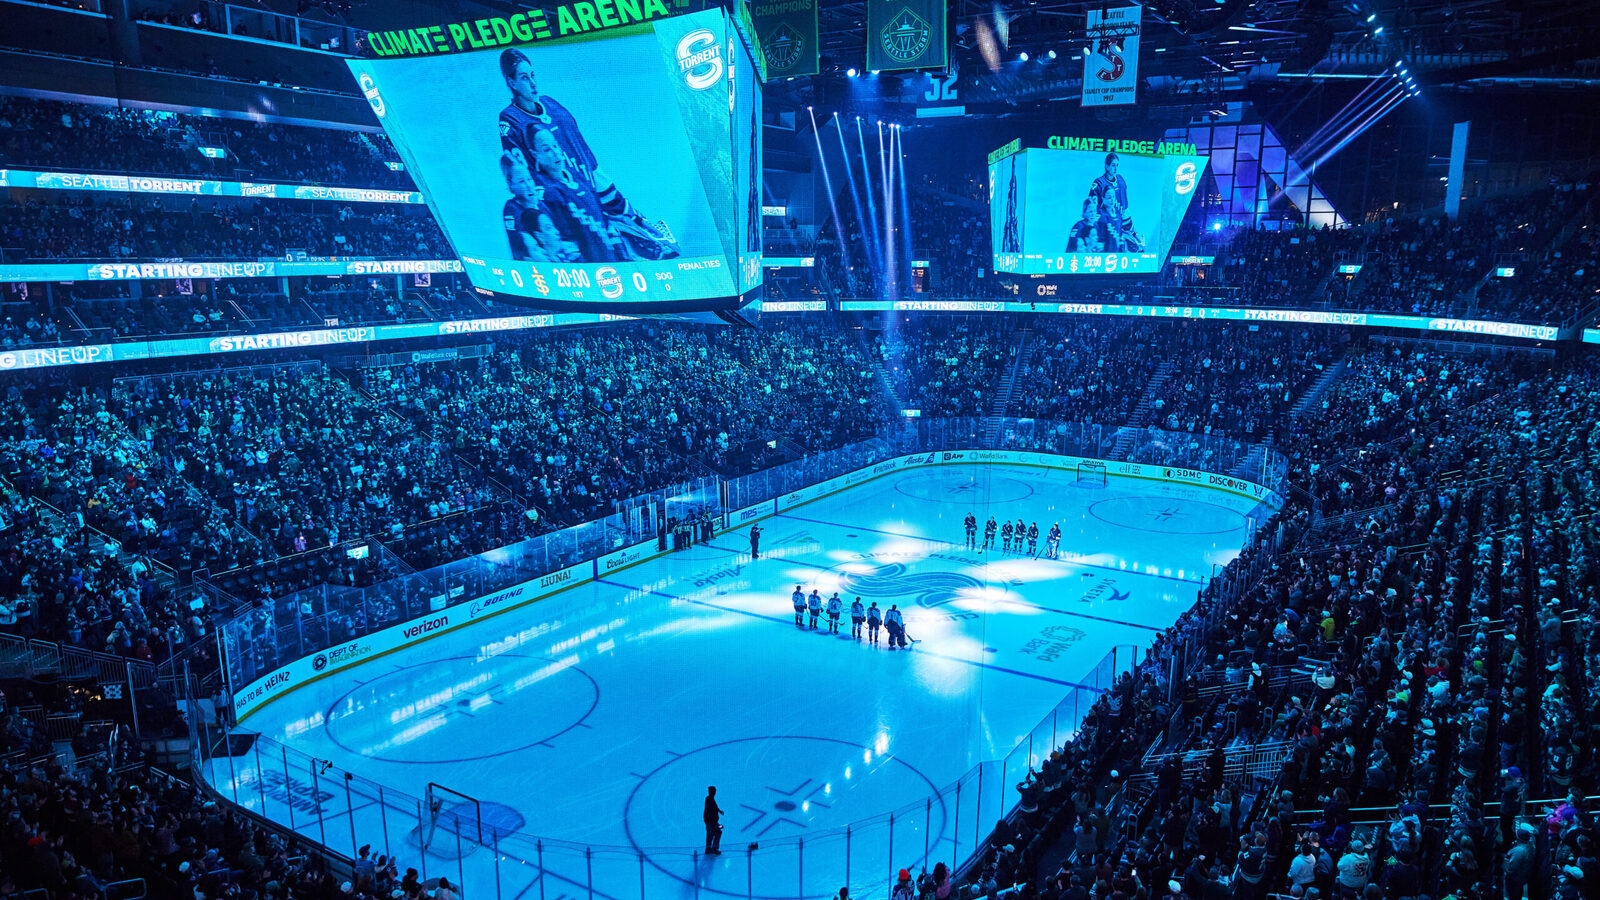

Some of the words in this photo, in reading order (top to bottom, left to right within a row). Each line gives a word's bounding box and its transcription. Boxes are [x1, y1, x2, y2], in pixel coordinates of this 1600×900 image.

[367, 26, 450, 57] CLIMATE
[448, 10, 552, 50] PLEDGE
[557, 0, 670, 36] ARENA
[679, 43, 721, 71] TORRENT
[1048, 135, 1104, 152] CLIMATE
[1106, 139, 1154, 154] PLEDGE
[1156, 142, 1197, 156] ARENA
[62, 176, 129, 190] SEATTLE
[130, 179, 202, 193] TORRENT
[311, 188, 358, 200] SEATTLE
[360, 190, 410, 203] TORRENT
[100, 263, 202, 279] STARTING
[208, 263, 266, 278] LINEUP
[353, 261, 425, 273] STARTING
[431, 261, 464, 273] LINEU
[676, 260, 721, 272] PENALTIES
[510, 269, 524, 288] 0
[552, 267, 591, 288] 20:00
[632, 271, 647, 292] 0
[655, 271, 673, 281] SOG
[899, 301, 957, 311] STARTING
[1066, 304, 1102, 313] START
[446, 318, 509, 334] STARTING
[512, 315, 548, 329] LINEUP
[1244, 310, 1310, 323] STARTING
[1316, 313, 1360, 325] LINEUP
[1436, 319, 1510, 335] STARTING
[1513, 325, 1556, 339] LINEUP
[218, 332, 309, 352] STARTING
[316, 330, 368, 344] LINEUP
[22, 347, 100, 367] LINEUP
[1176, 469, 1202, 480] SDMC
[1209, 475, 1248, 492] DISCOVER
[692, 564, 747, 588] Alaska
[483, 587, 524, 608] BOEING
[403, 616, 449, 640] verizon
[328, 646, 347, 659] DEPT
[348, 643, 359, 652] OF
[235, 696, 248, 711] HAS
[247, 691, 255, 702] TO
[255, 686, 264, 697] BE
[264, 671, 291, 691] HEINZ
